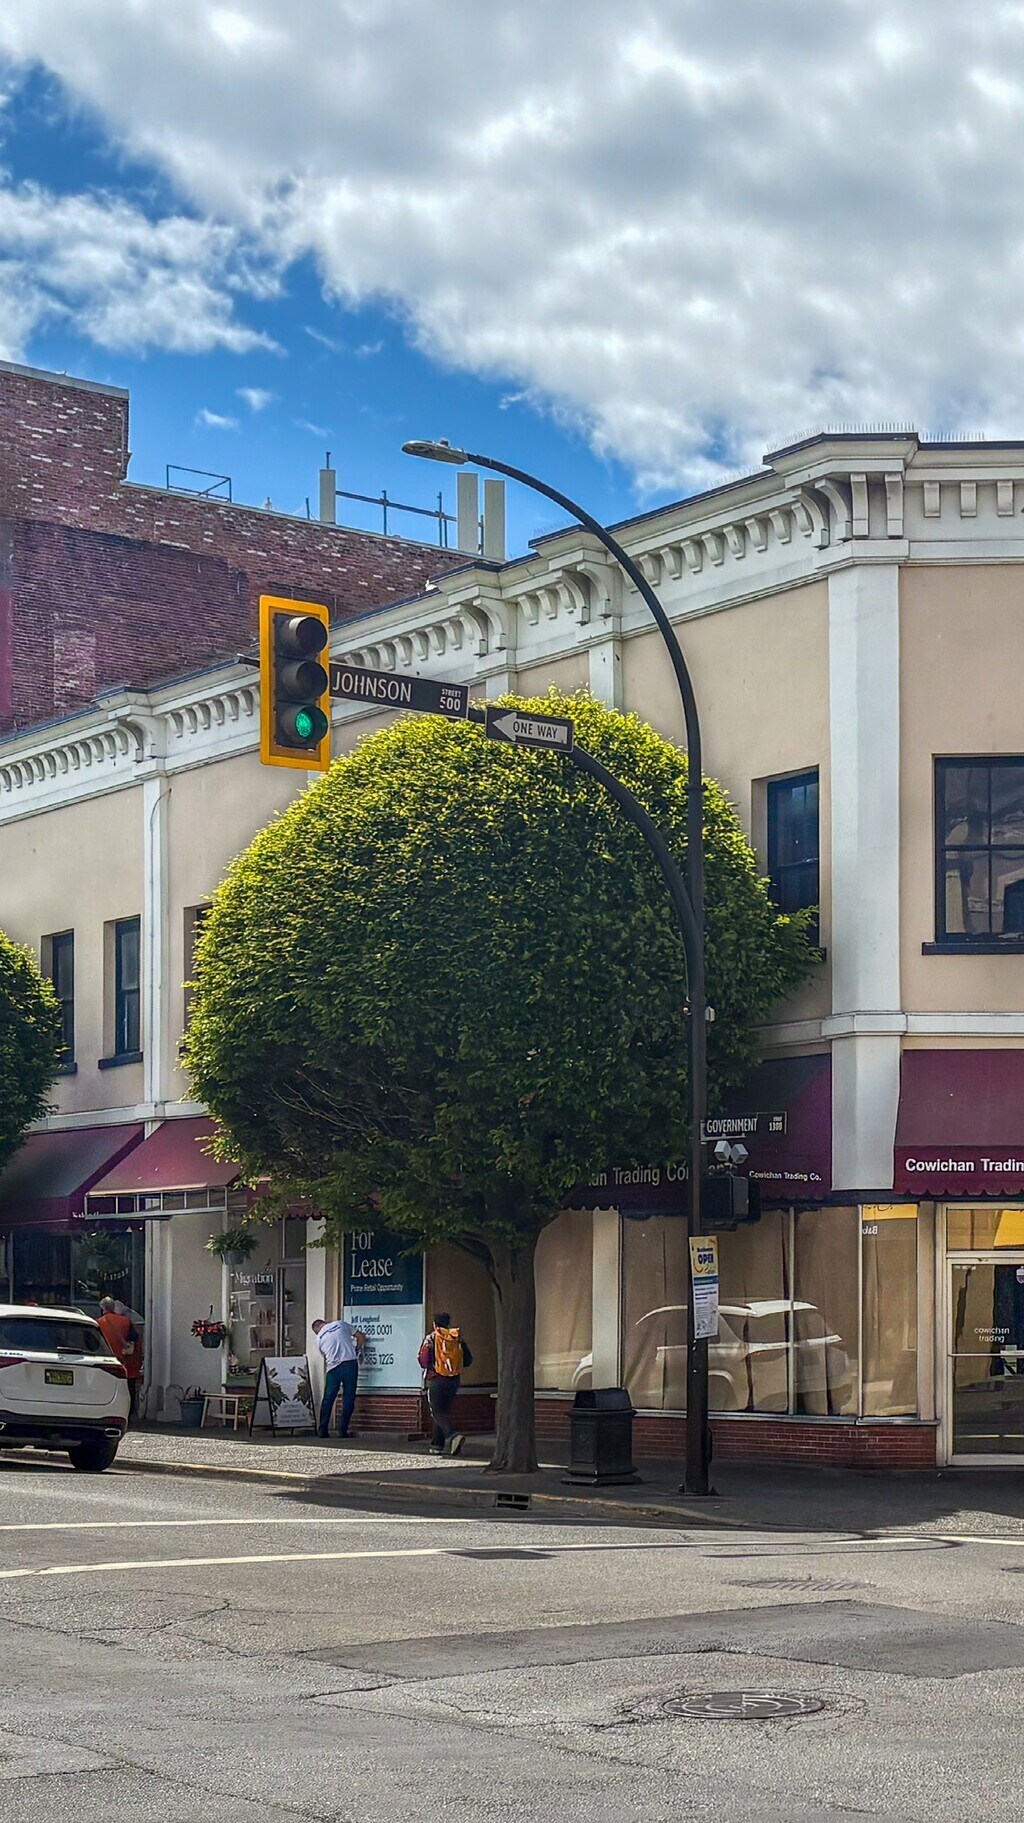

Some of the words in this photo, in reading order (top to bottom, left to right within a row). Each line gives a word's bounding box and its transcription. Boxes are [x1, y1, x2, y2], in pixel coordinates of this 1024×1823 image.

[332, 671, 412, 703] JOHNSON
[441, 688, 462, 698] STREET
[439, 696, 461, 711] 500
[513, 720, 533, 736] ONE
[537, 723, 558, 739] WAY
[706, 1118, 758, 1133] GOVERNMENT
[769, 1122, 783, 1131] 1300
[905, 1158, 975, 1173] Cowichan
[613, 1165, 660, 1186] Trading
[749, 1170, 782, 1179] Cowichan
[784, 1171, 808, 1181] Trading
[809, 1172, 822, 1181] Co.
[351, 1231, 374, 1250] For
[351, 1253, 393, 1278] Lease
[234, 1272, 274, 1286] Migration
[376, 1324, 393, 1336] 0001
[973, 1326, 1010, 1334] cowichan
[978, 1335, 1005, 1343] trading
[378, 1353, 395, 1365] 1225
